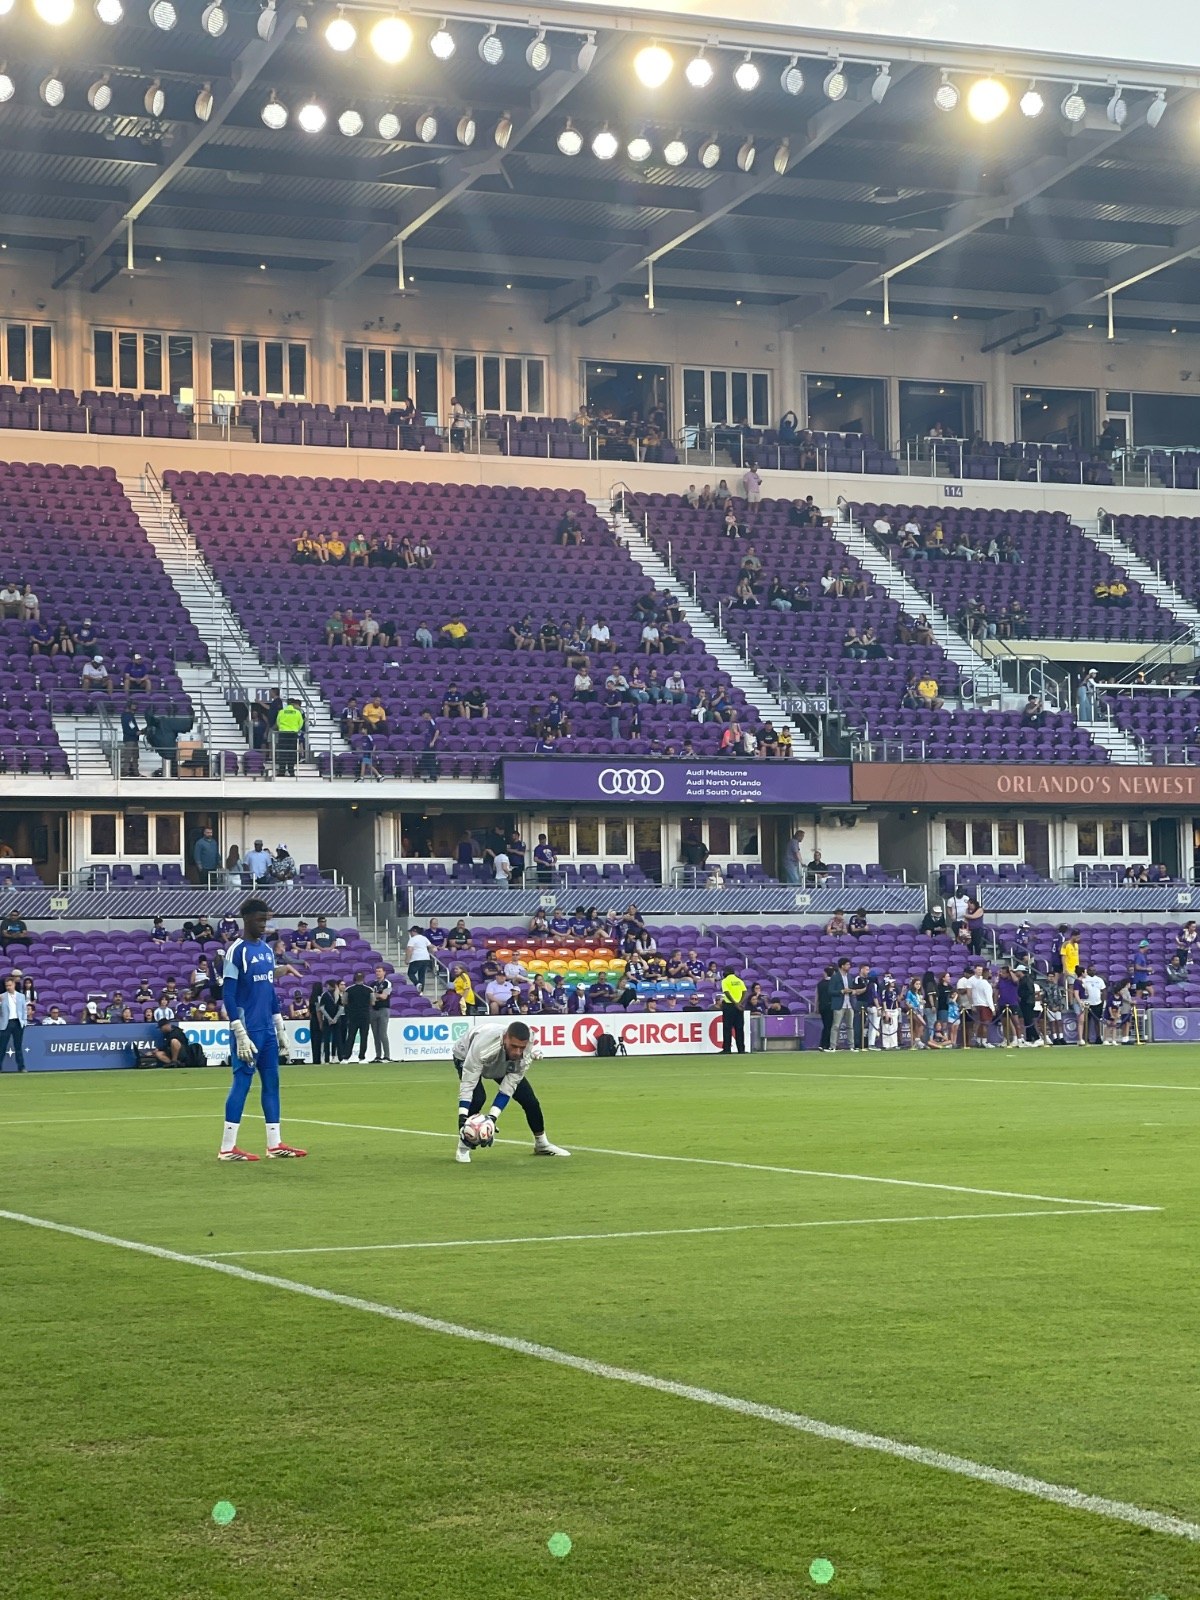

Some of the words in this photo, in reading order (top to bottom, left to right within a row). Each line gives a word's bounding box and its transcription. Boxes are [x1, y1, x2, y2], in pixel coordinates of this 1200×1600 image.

[945, 486, 962, 496] 114
[226, 689, 246, 700] 11
[997, 775, 1111, 793] ORLANDO'S
[1119, 776, 1196, 794] NEWEST
[403, 1024, 449, 1041] OUC
[622, 1023, 702, 1044] CIRCLE
[50, 1041, 128, 1052] UNBELIEVABLY
[404, 1047, 418, 1055] The
[421, 1045, 451, 1054] Reliable
[295, 1049, 310, 1057] The
